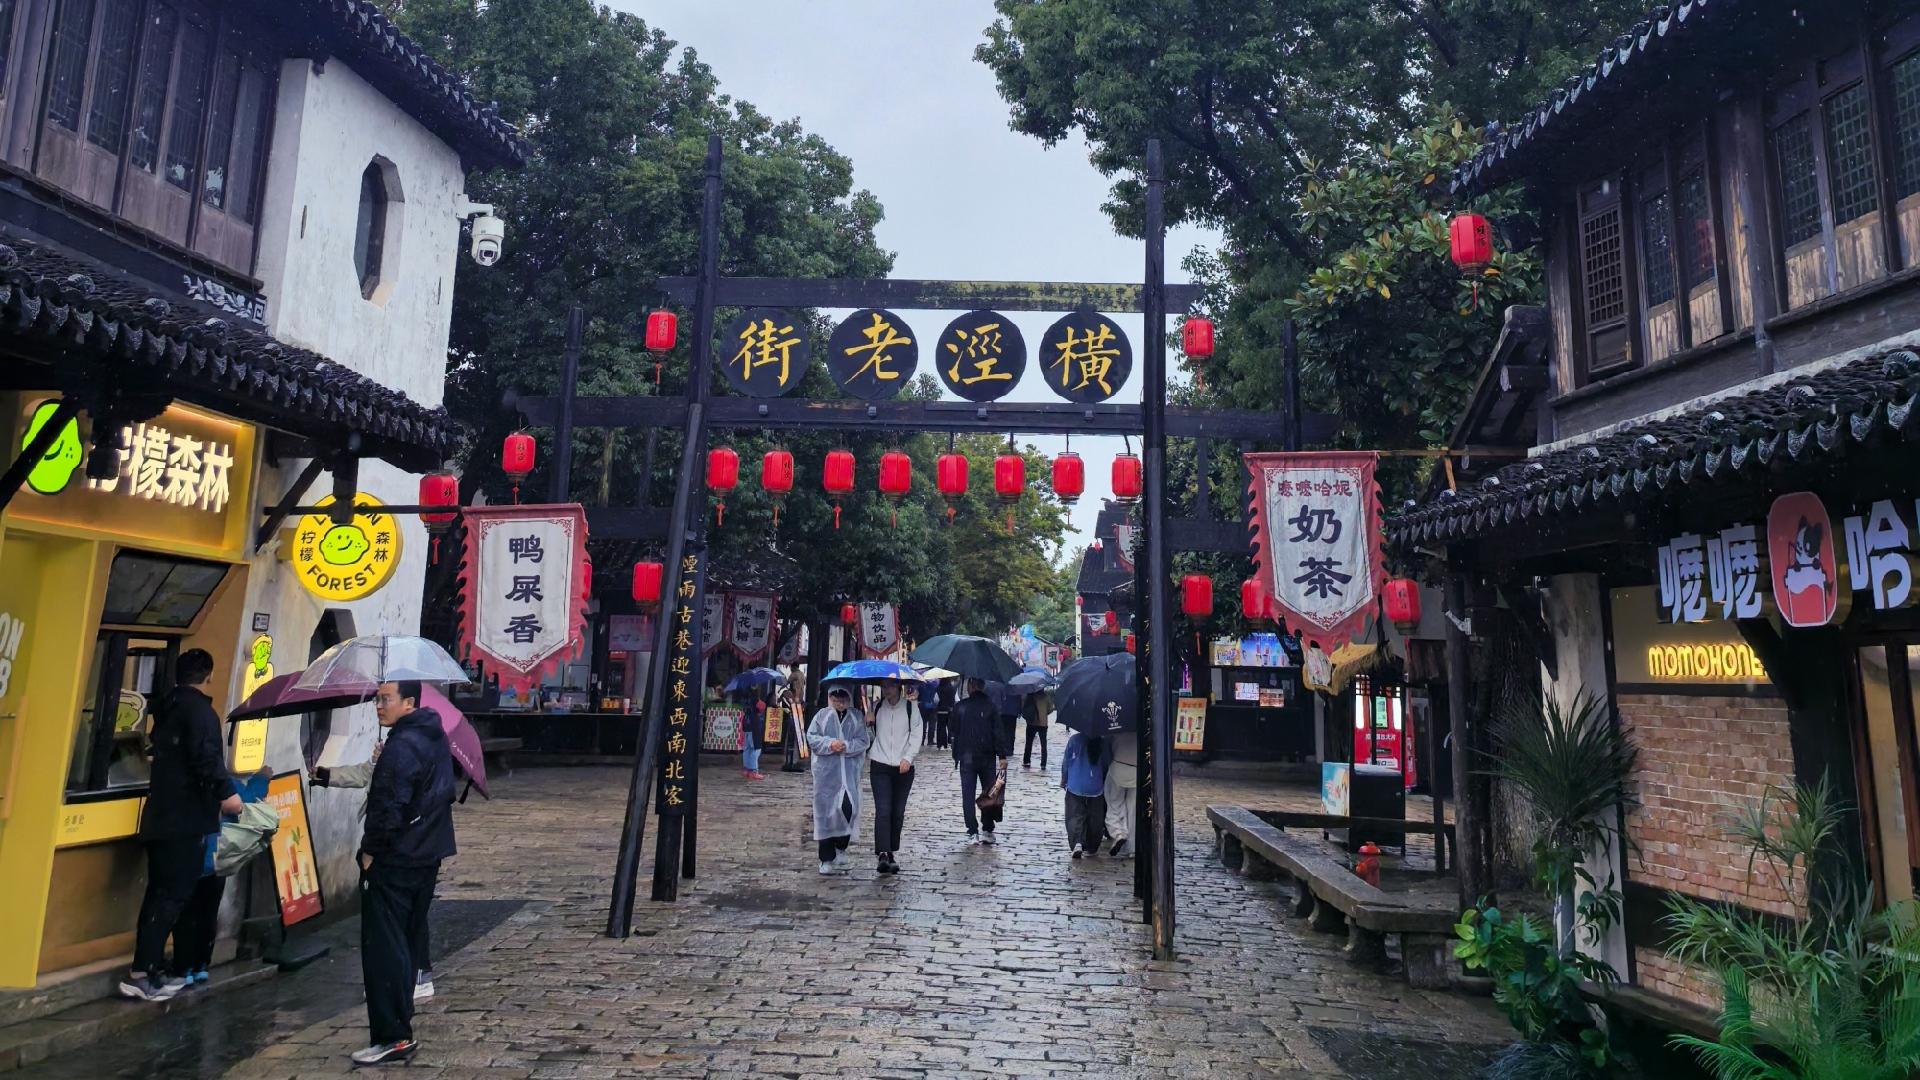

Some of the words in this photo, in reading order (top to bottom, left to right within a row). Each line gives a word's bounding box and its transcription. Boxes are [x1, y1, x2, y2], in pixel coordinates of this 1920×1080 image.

[89, 422, 233, 512] 檬森林
[307, 564, 376, 591] FOREST
[374, 531, 390, 562] 森林
[503, 534, 544, 644] 鸭屎香
[1288, 505, 1353, 598] 奶茶
[1844, 498, 1920, 610] 哈
[1648, 643, 1768, 677] MOMOHONE
